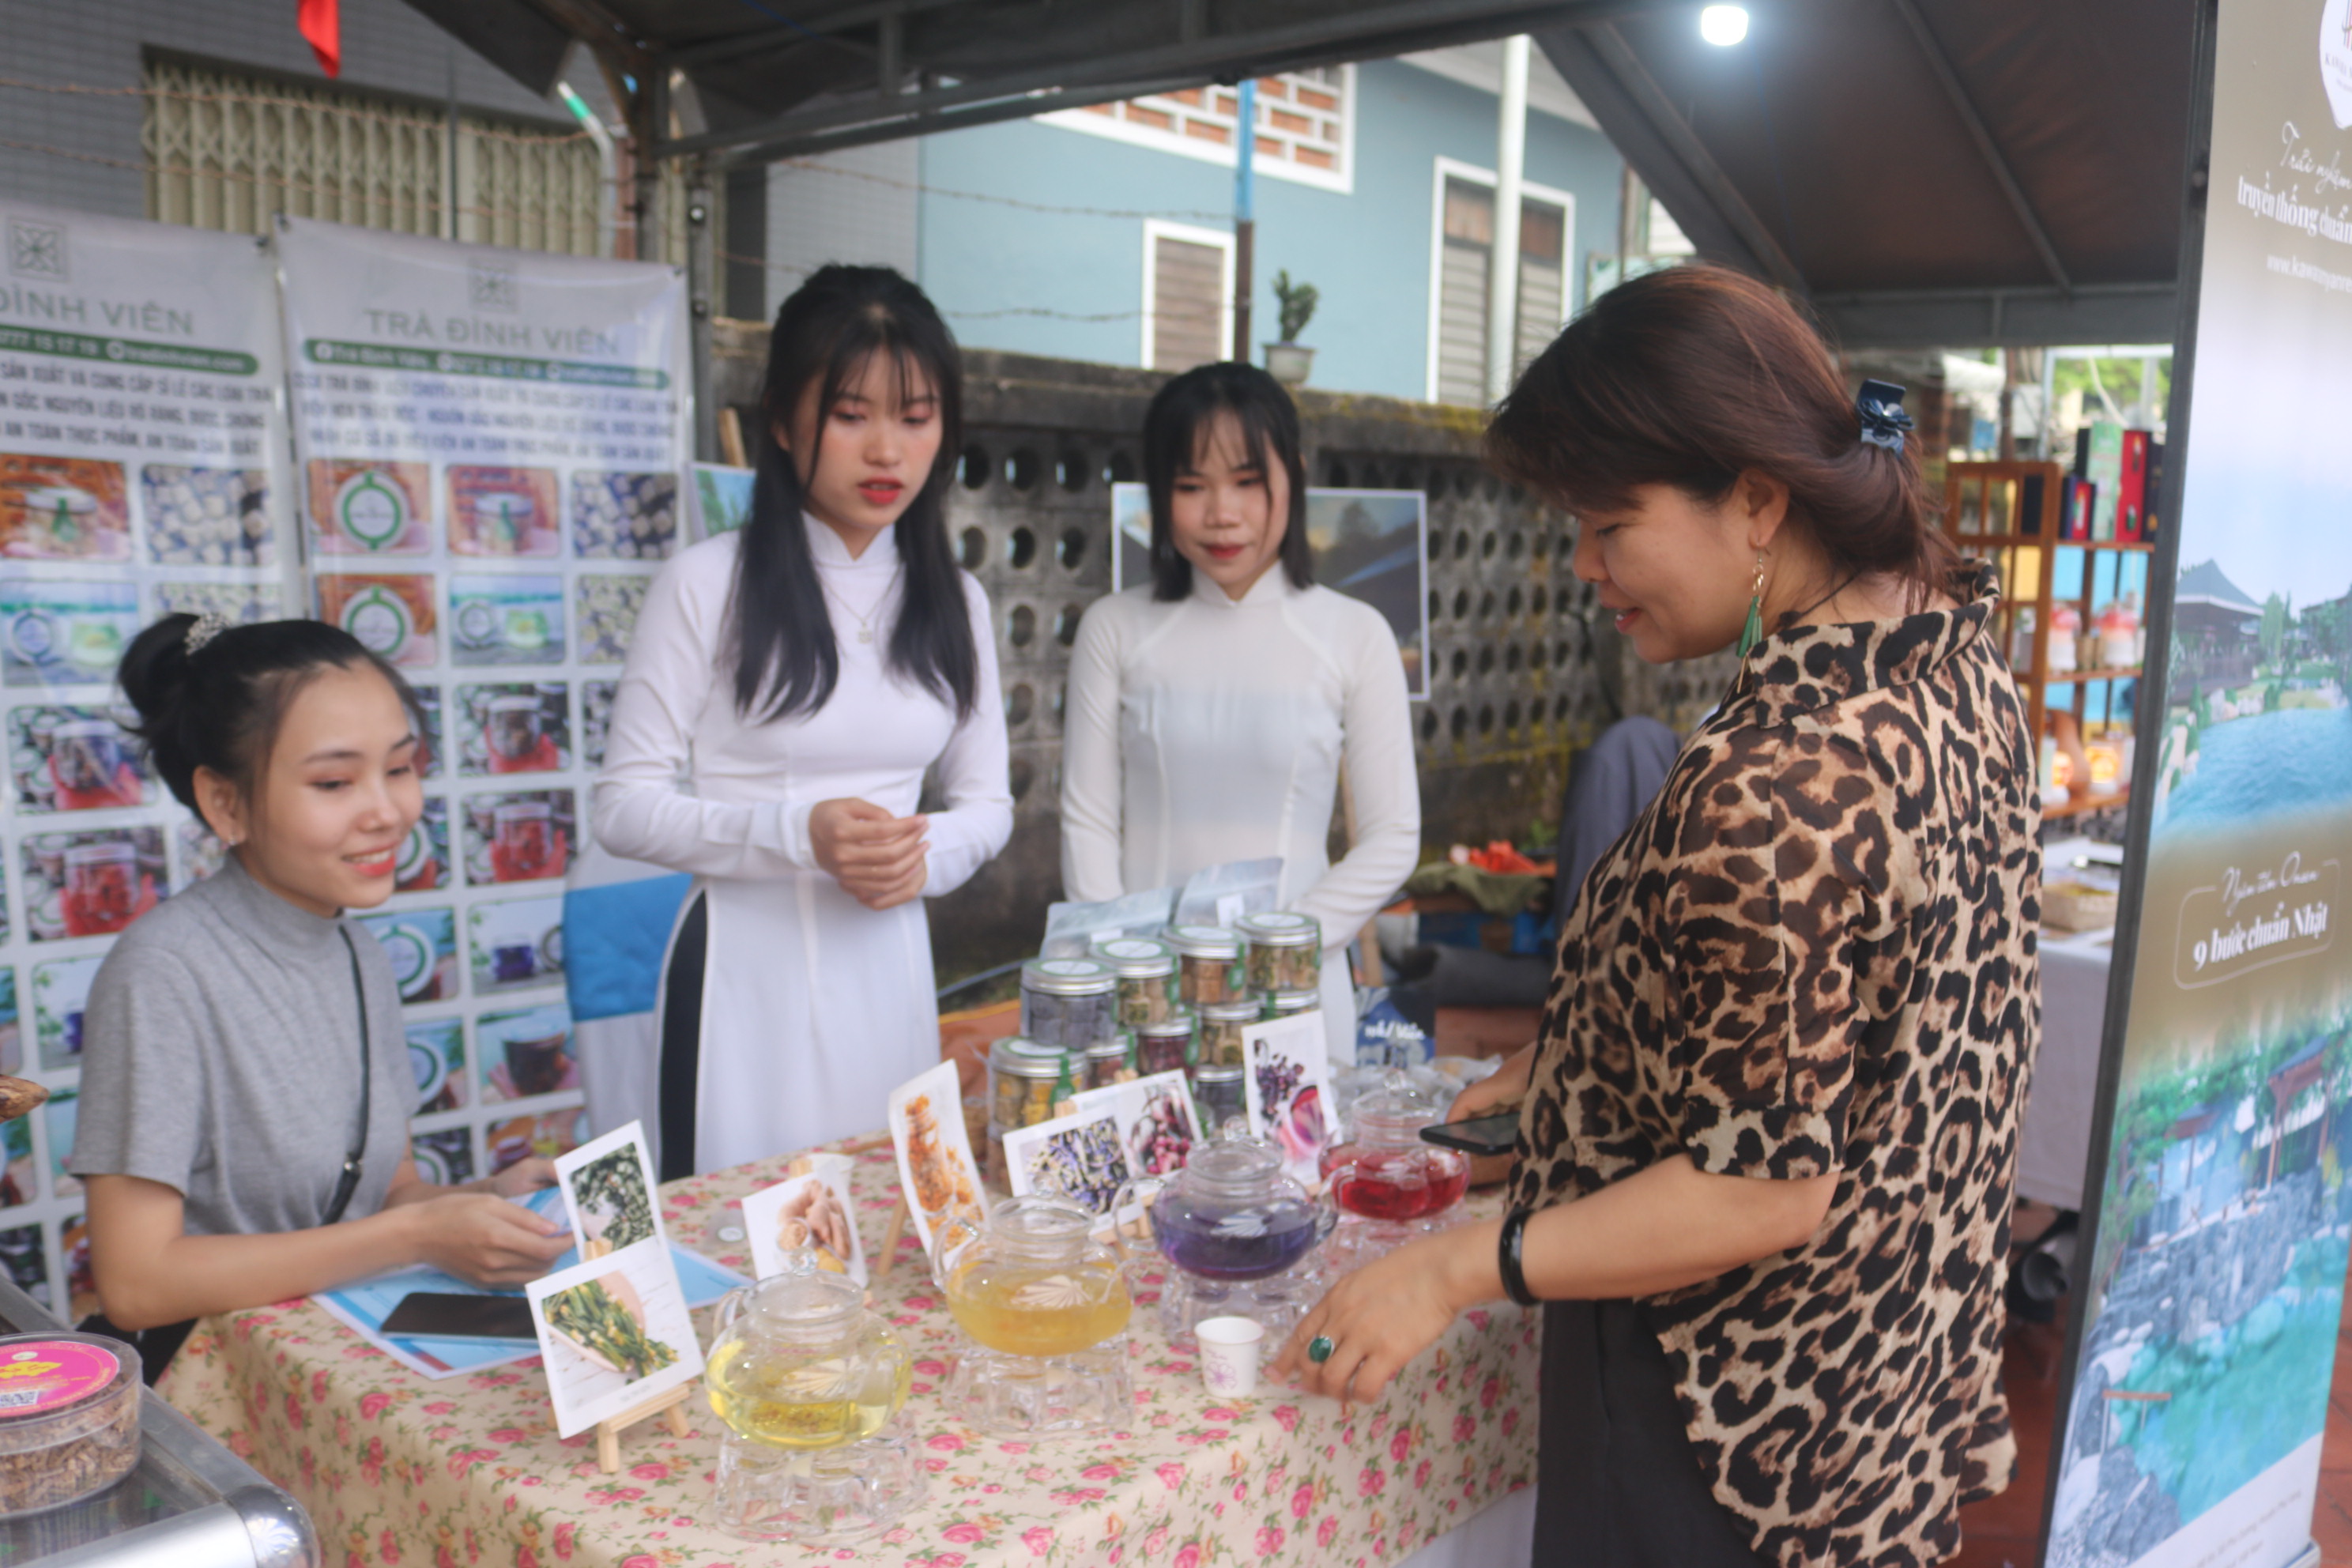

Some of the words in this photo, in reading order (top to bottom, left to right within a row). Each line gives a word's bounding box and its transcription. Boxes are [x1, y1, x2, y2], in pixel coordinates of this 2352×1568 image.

[2275, 184, 2320, 236] thống
[99, 300, 194, 335] VIÊN
[364, 310, 435, 340] TRÀ
[445, 317, 533, 350] ĐÌNH
[542, 325, 620, 356] VIÊN
[2193, 939, 2207, 972] 9
[2211, 921, 2247, 963] bước
[2247, 900, 2290, 951] chuẩn
[2294, 900, 2328, 940] Nhật
